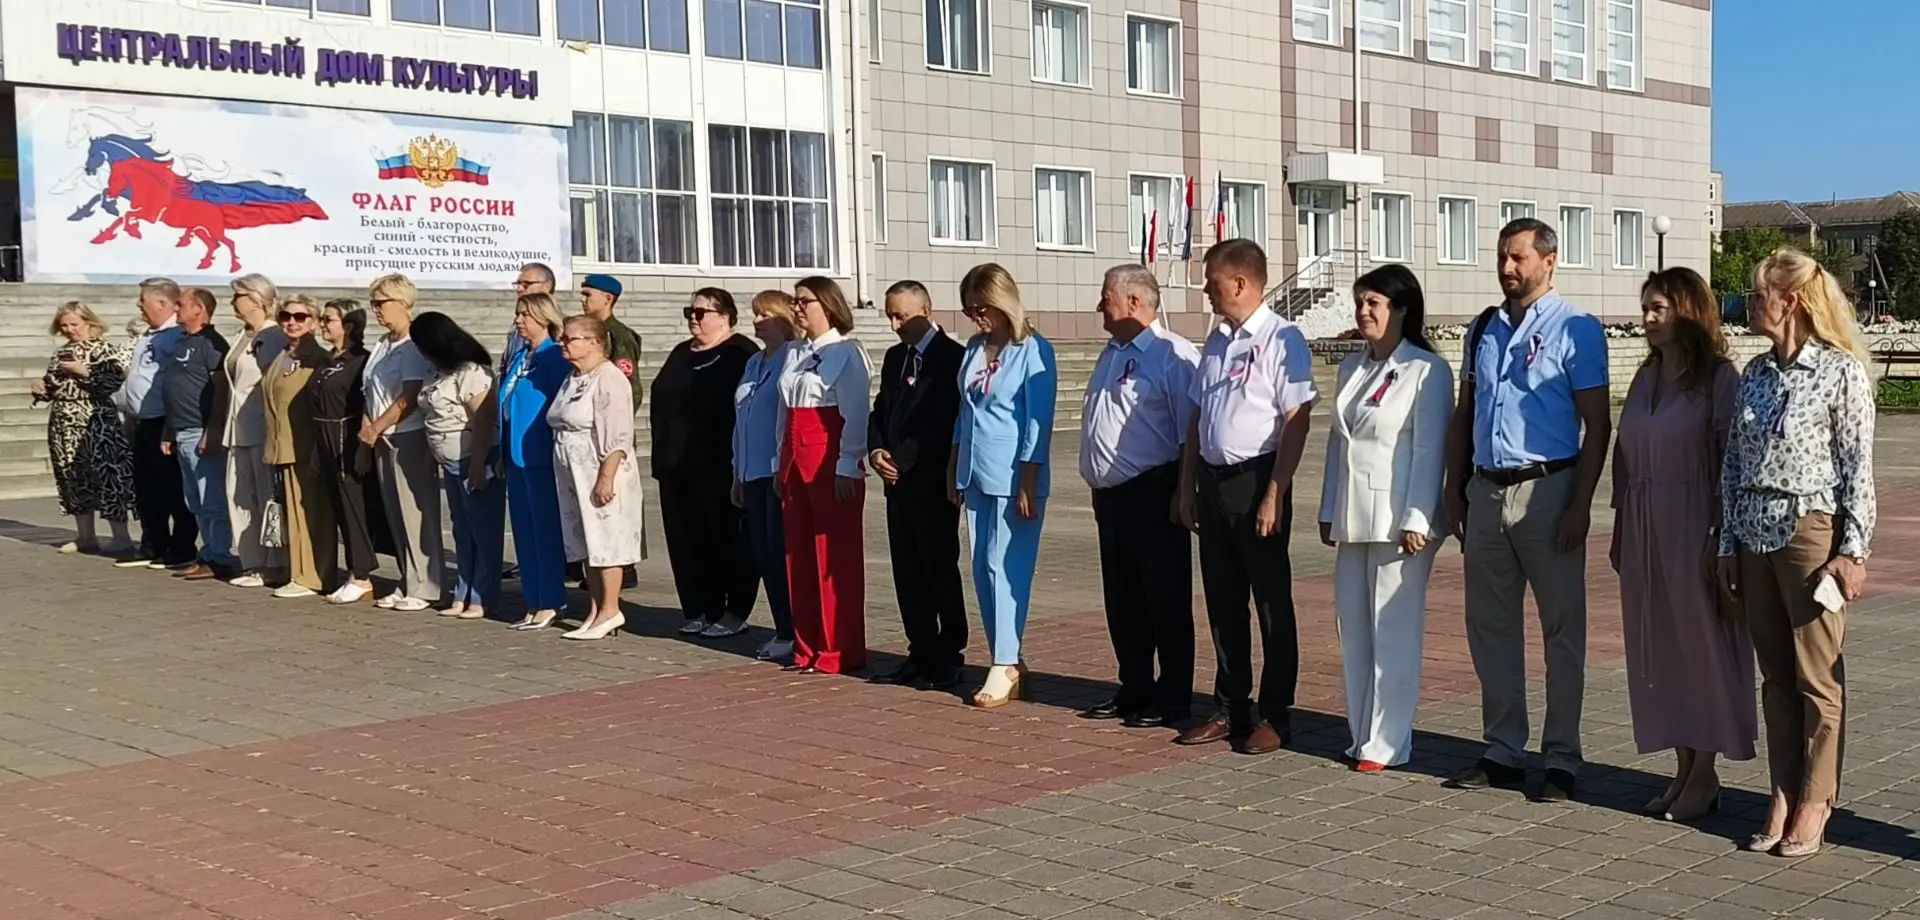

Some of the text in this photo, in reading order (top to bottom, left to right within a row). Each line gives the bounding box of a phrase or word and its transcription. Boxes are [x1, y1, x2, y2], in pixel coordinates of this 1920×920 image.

[56, 22, 538, 100] ЦЕНТРАЛЬНЫЙ ДОМ КУЛЬТУРЫ
[352, 192, 515, 216] ФЛАГ РОССИИ
[360, 215, 405, 229] Белый
[417, 217, 510, 234] благородство,
[374, 231, 416, 242] синий
[428, 234, 498, 247] честность,
[313, 244, 376, 257] красный
[388, 246, 449, 258] смелость
[452, 249, 460, 258] и
[464, 248, 552, 263] великодушие,
[345, 258, 416, 270] присущие
[419, 261, 475, 273] русским
